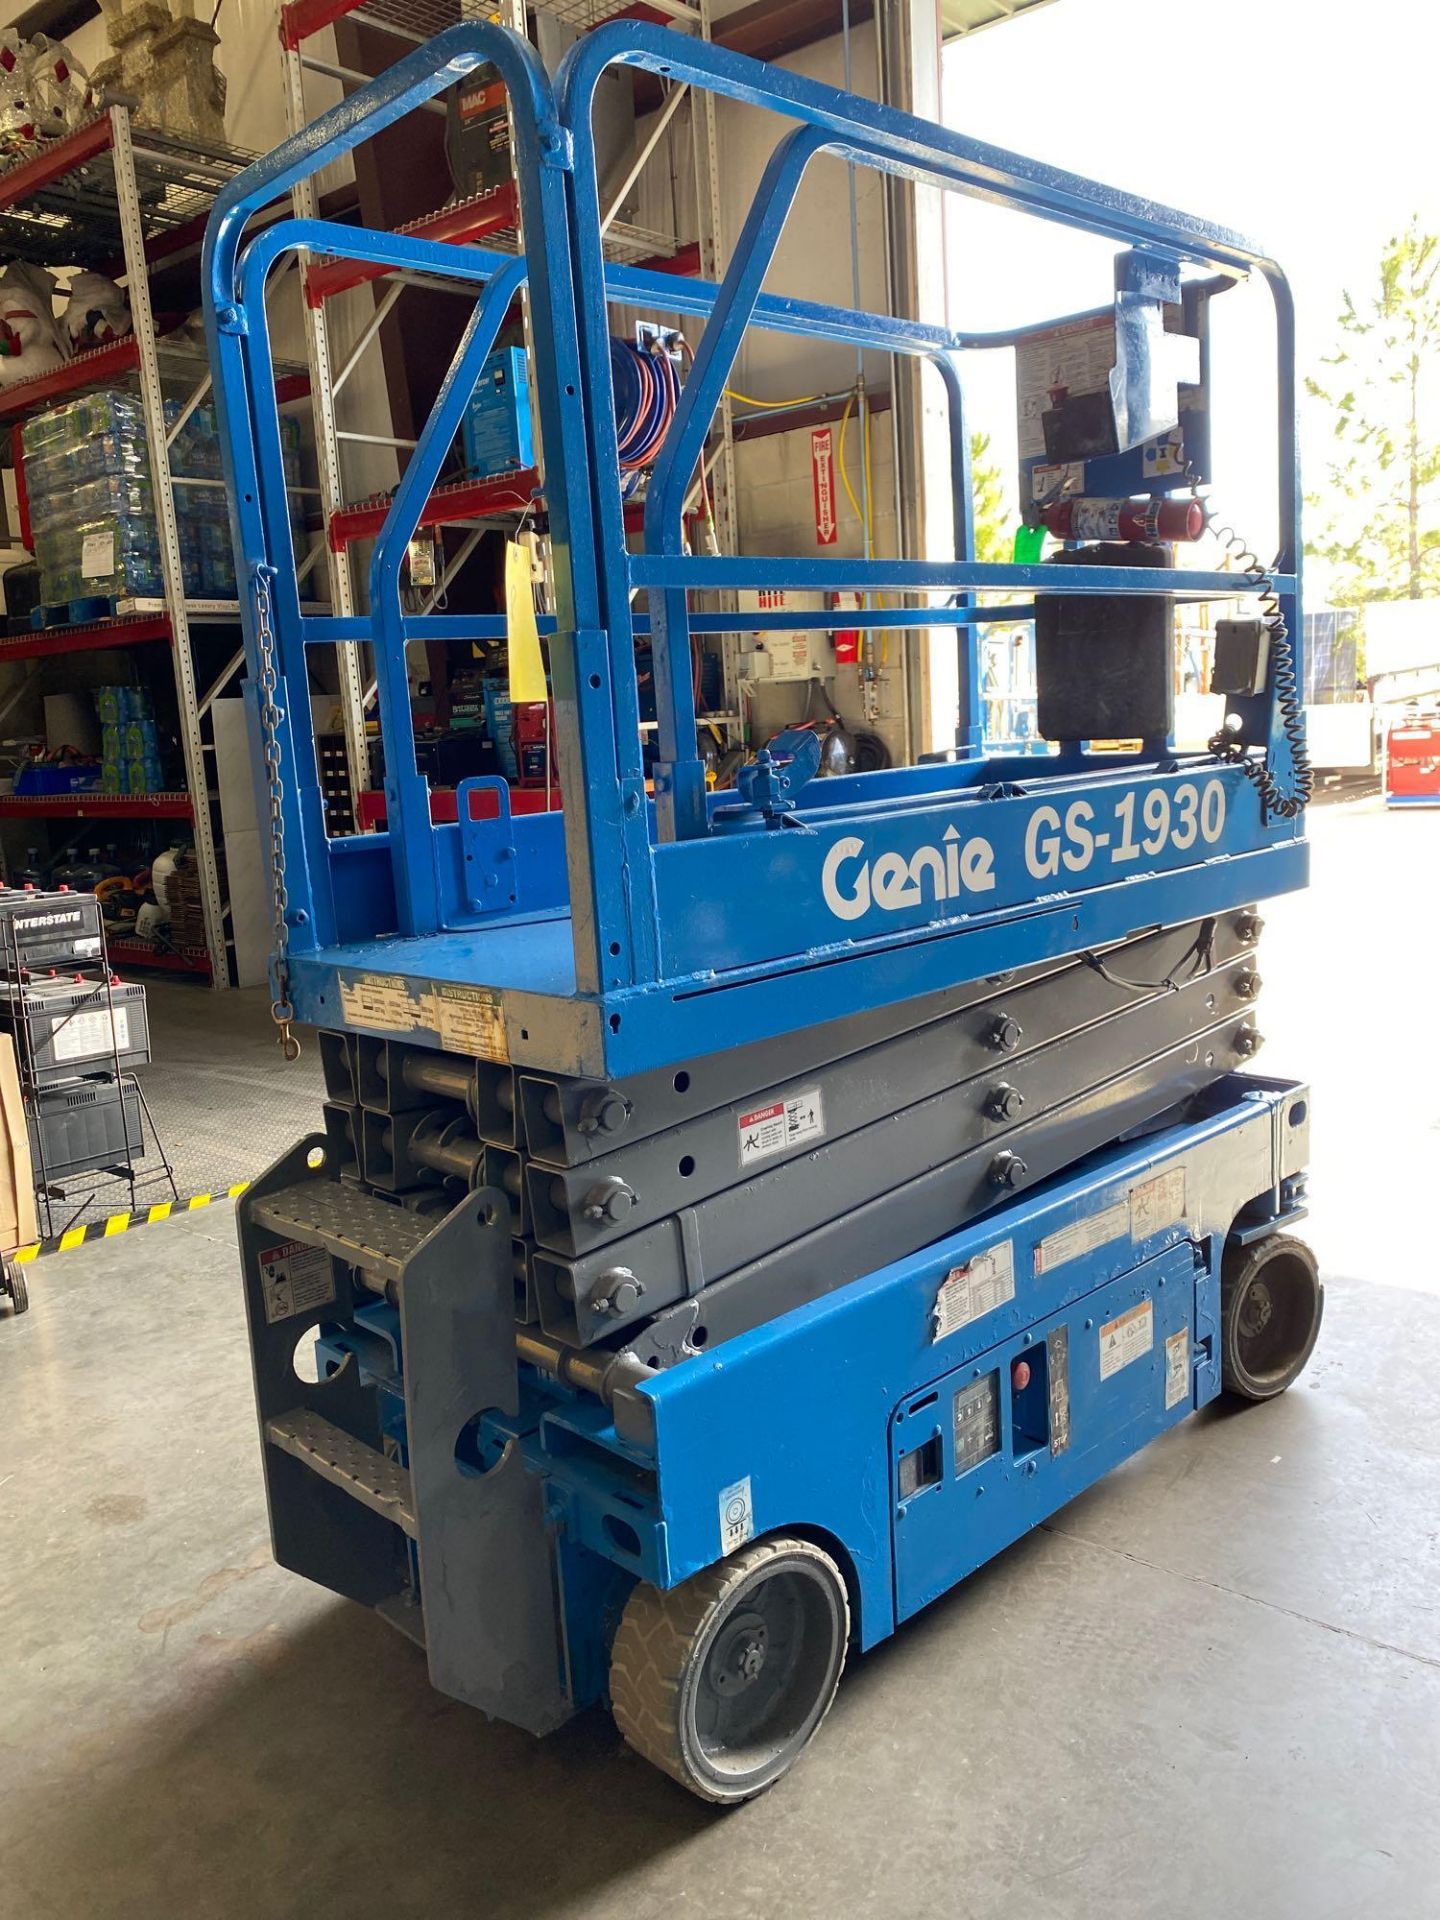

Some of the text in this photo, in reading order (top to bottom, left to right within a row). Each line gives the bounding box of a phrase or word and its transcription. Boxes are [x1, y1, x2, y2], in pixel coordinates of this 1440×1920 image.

[462, 90, 487, 112] MAC
[815, 440, 830, 452] FIRE
[819, 455, 830, 535] EXTINGUISHER
[822, 779, 1226, 921] Genie GS-1930
[13, 911, 81, 930] NTERSTATE
[753, 1107, 775, 1120] DANGER
